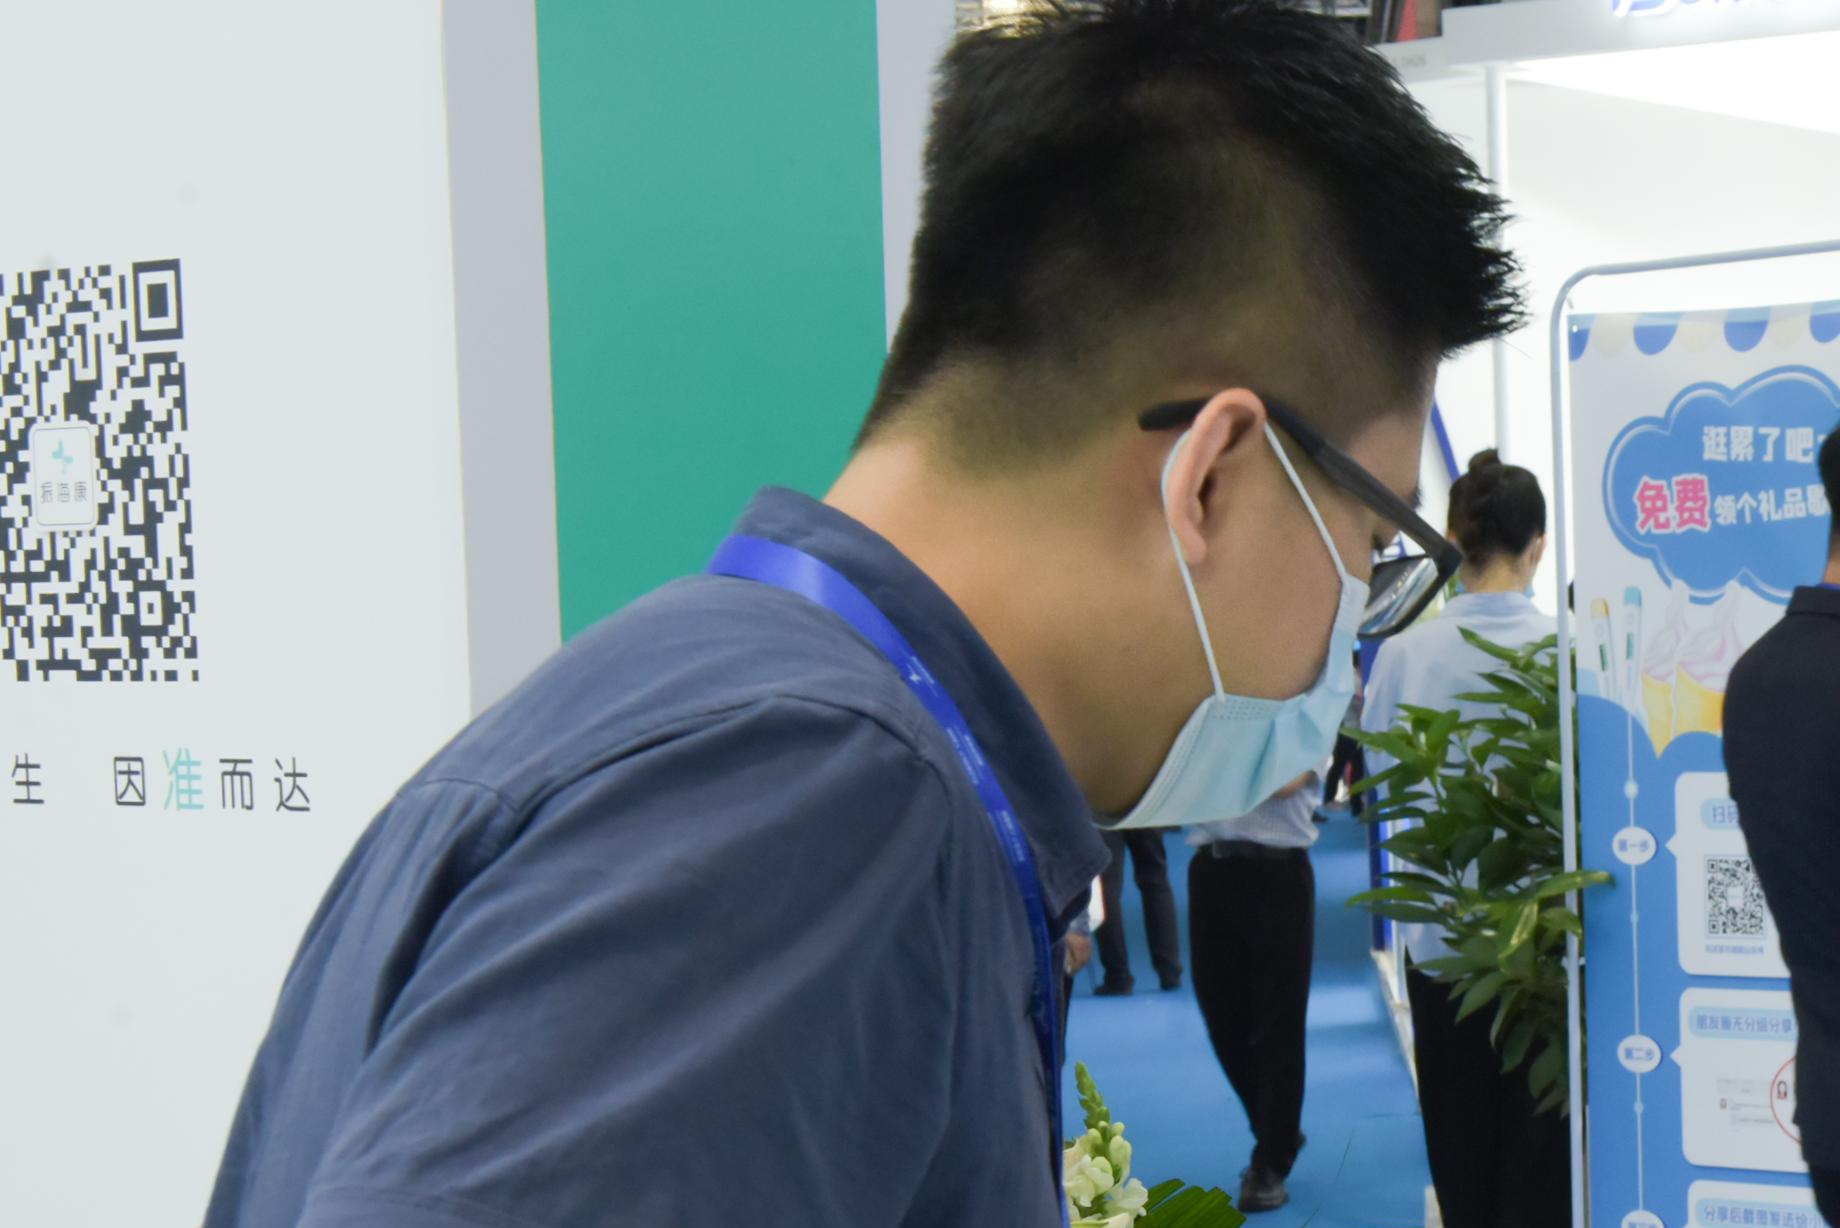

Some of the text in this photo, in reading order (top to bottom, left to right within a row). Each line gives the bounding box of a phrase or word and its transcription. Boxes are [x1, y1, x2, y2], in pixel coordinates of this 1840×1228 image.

[1702, 425, 1815, 464] 逛累了吧
[11, 747, 311, 812] 生 因准而达
